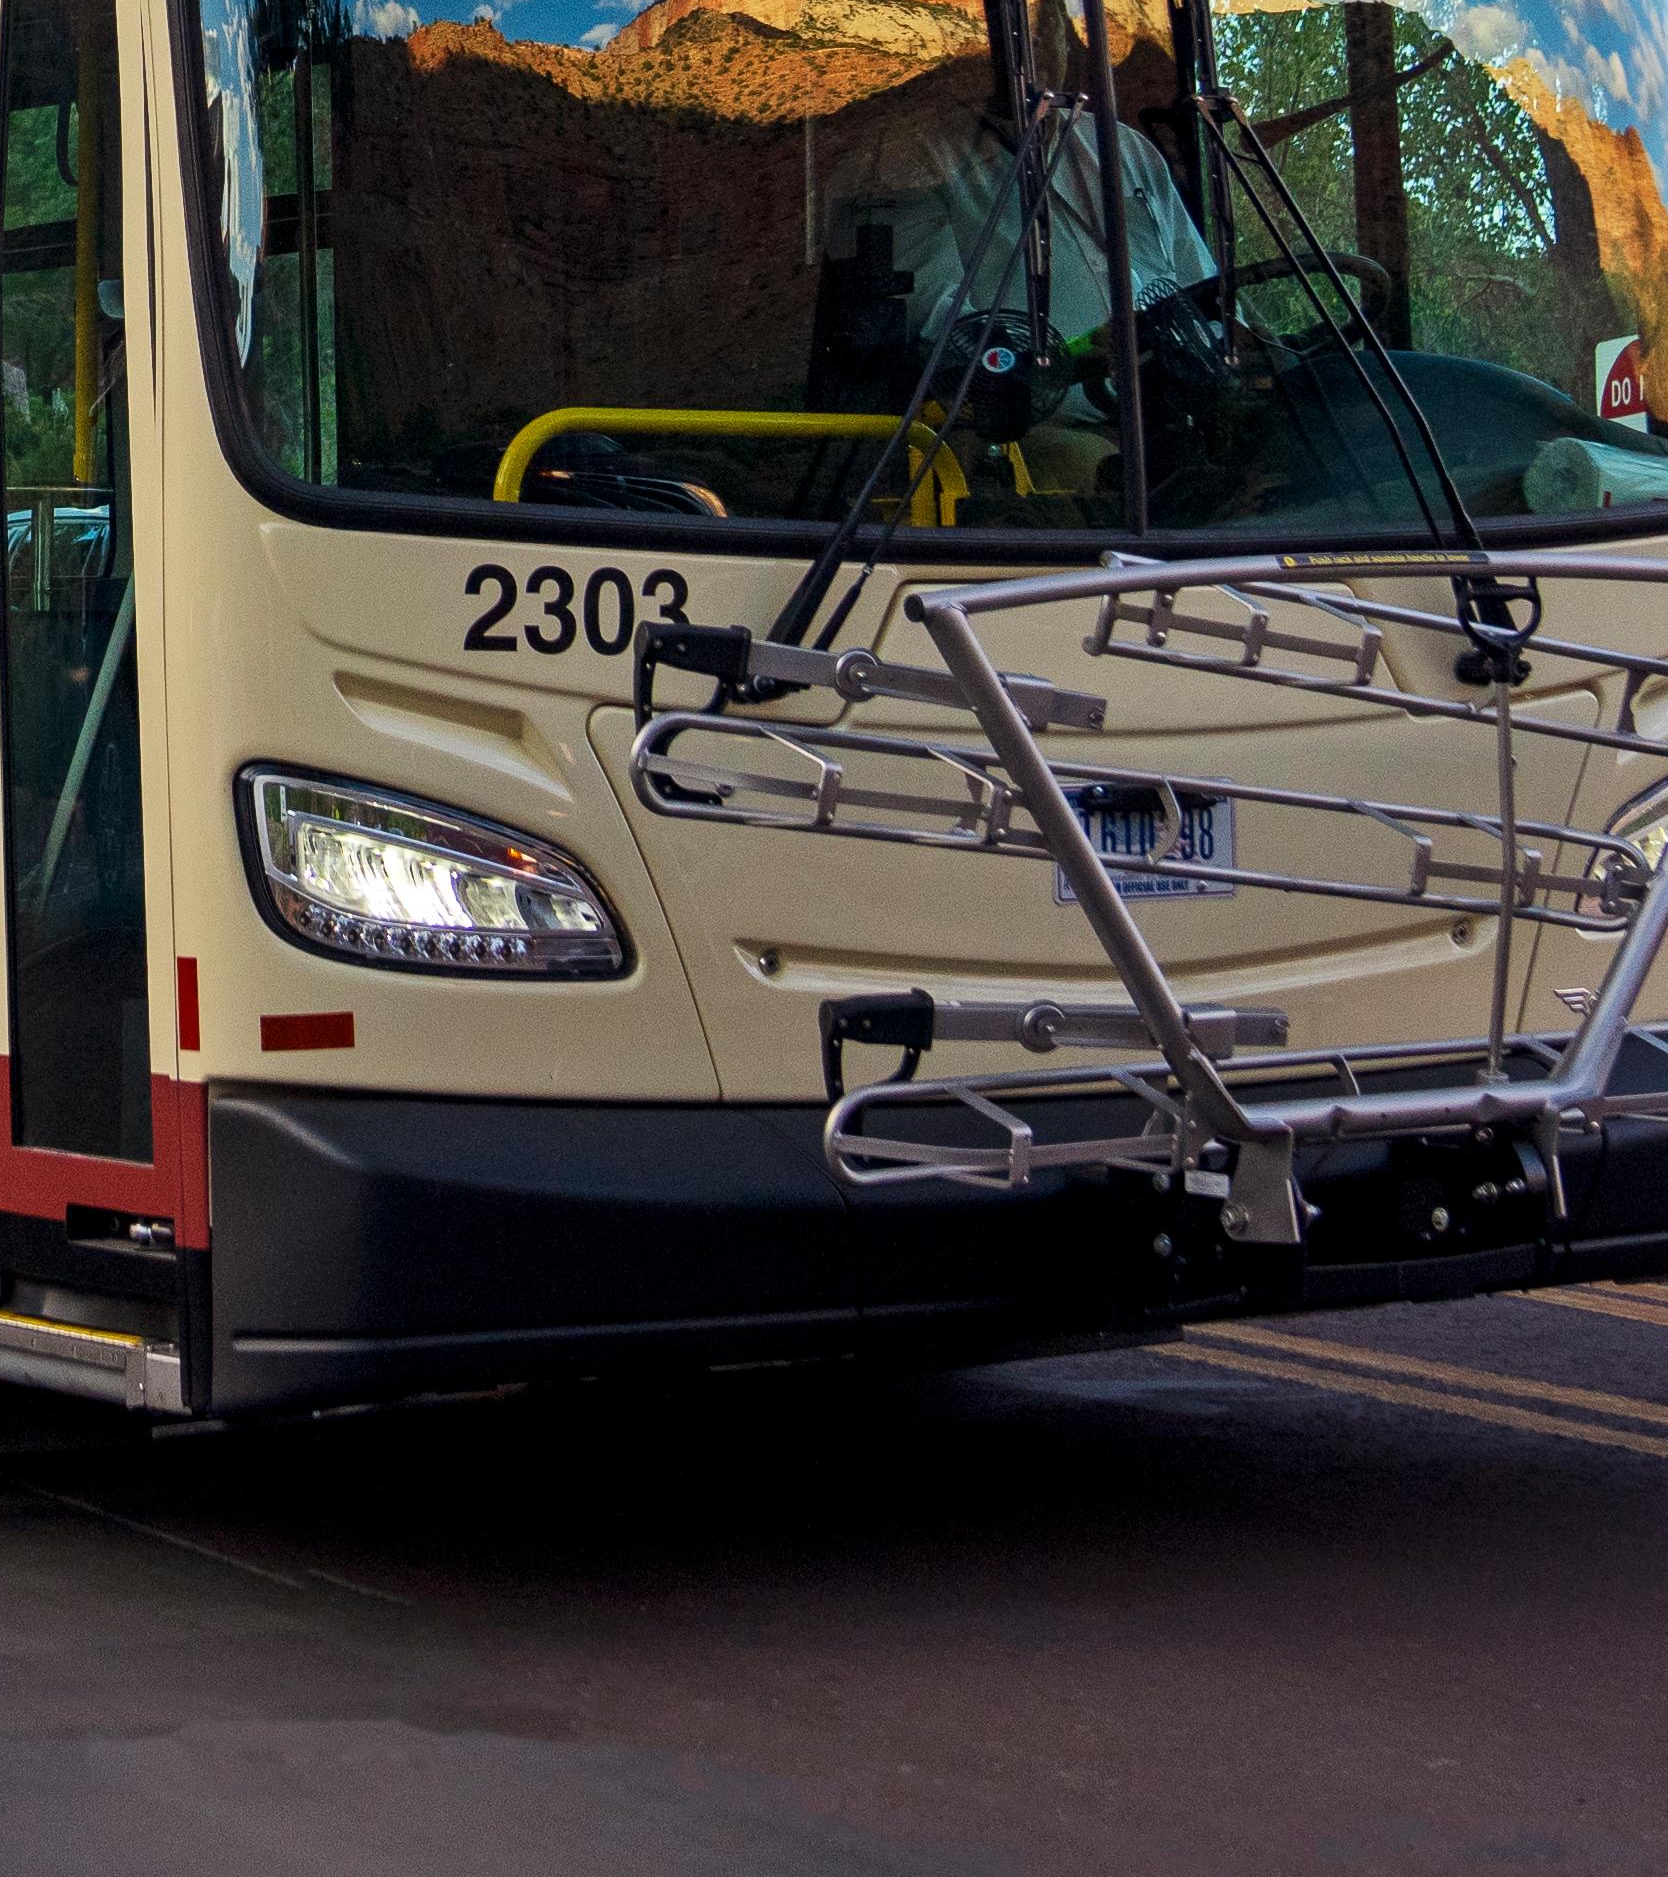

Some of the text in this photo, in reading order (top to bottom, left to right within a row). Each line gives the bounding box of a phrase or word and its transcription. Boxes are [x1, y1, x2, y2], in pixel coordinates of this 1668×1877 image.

[1612, 377, 1632, 408] DO
[463, 563, 691, 656] 2303
[1122, 880, 1154, 893] OFFICIAL
